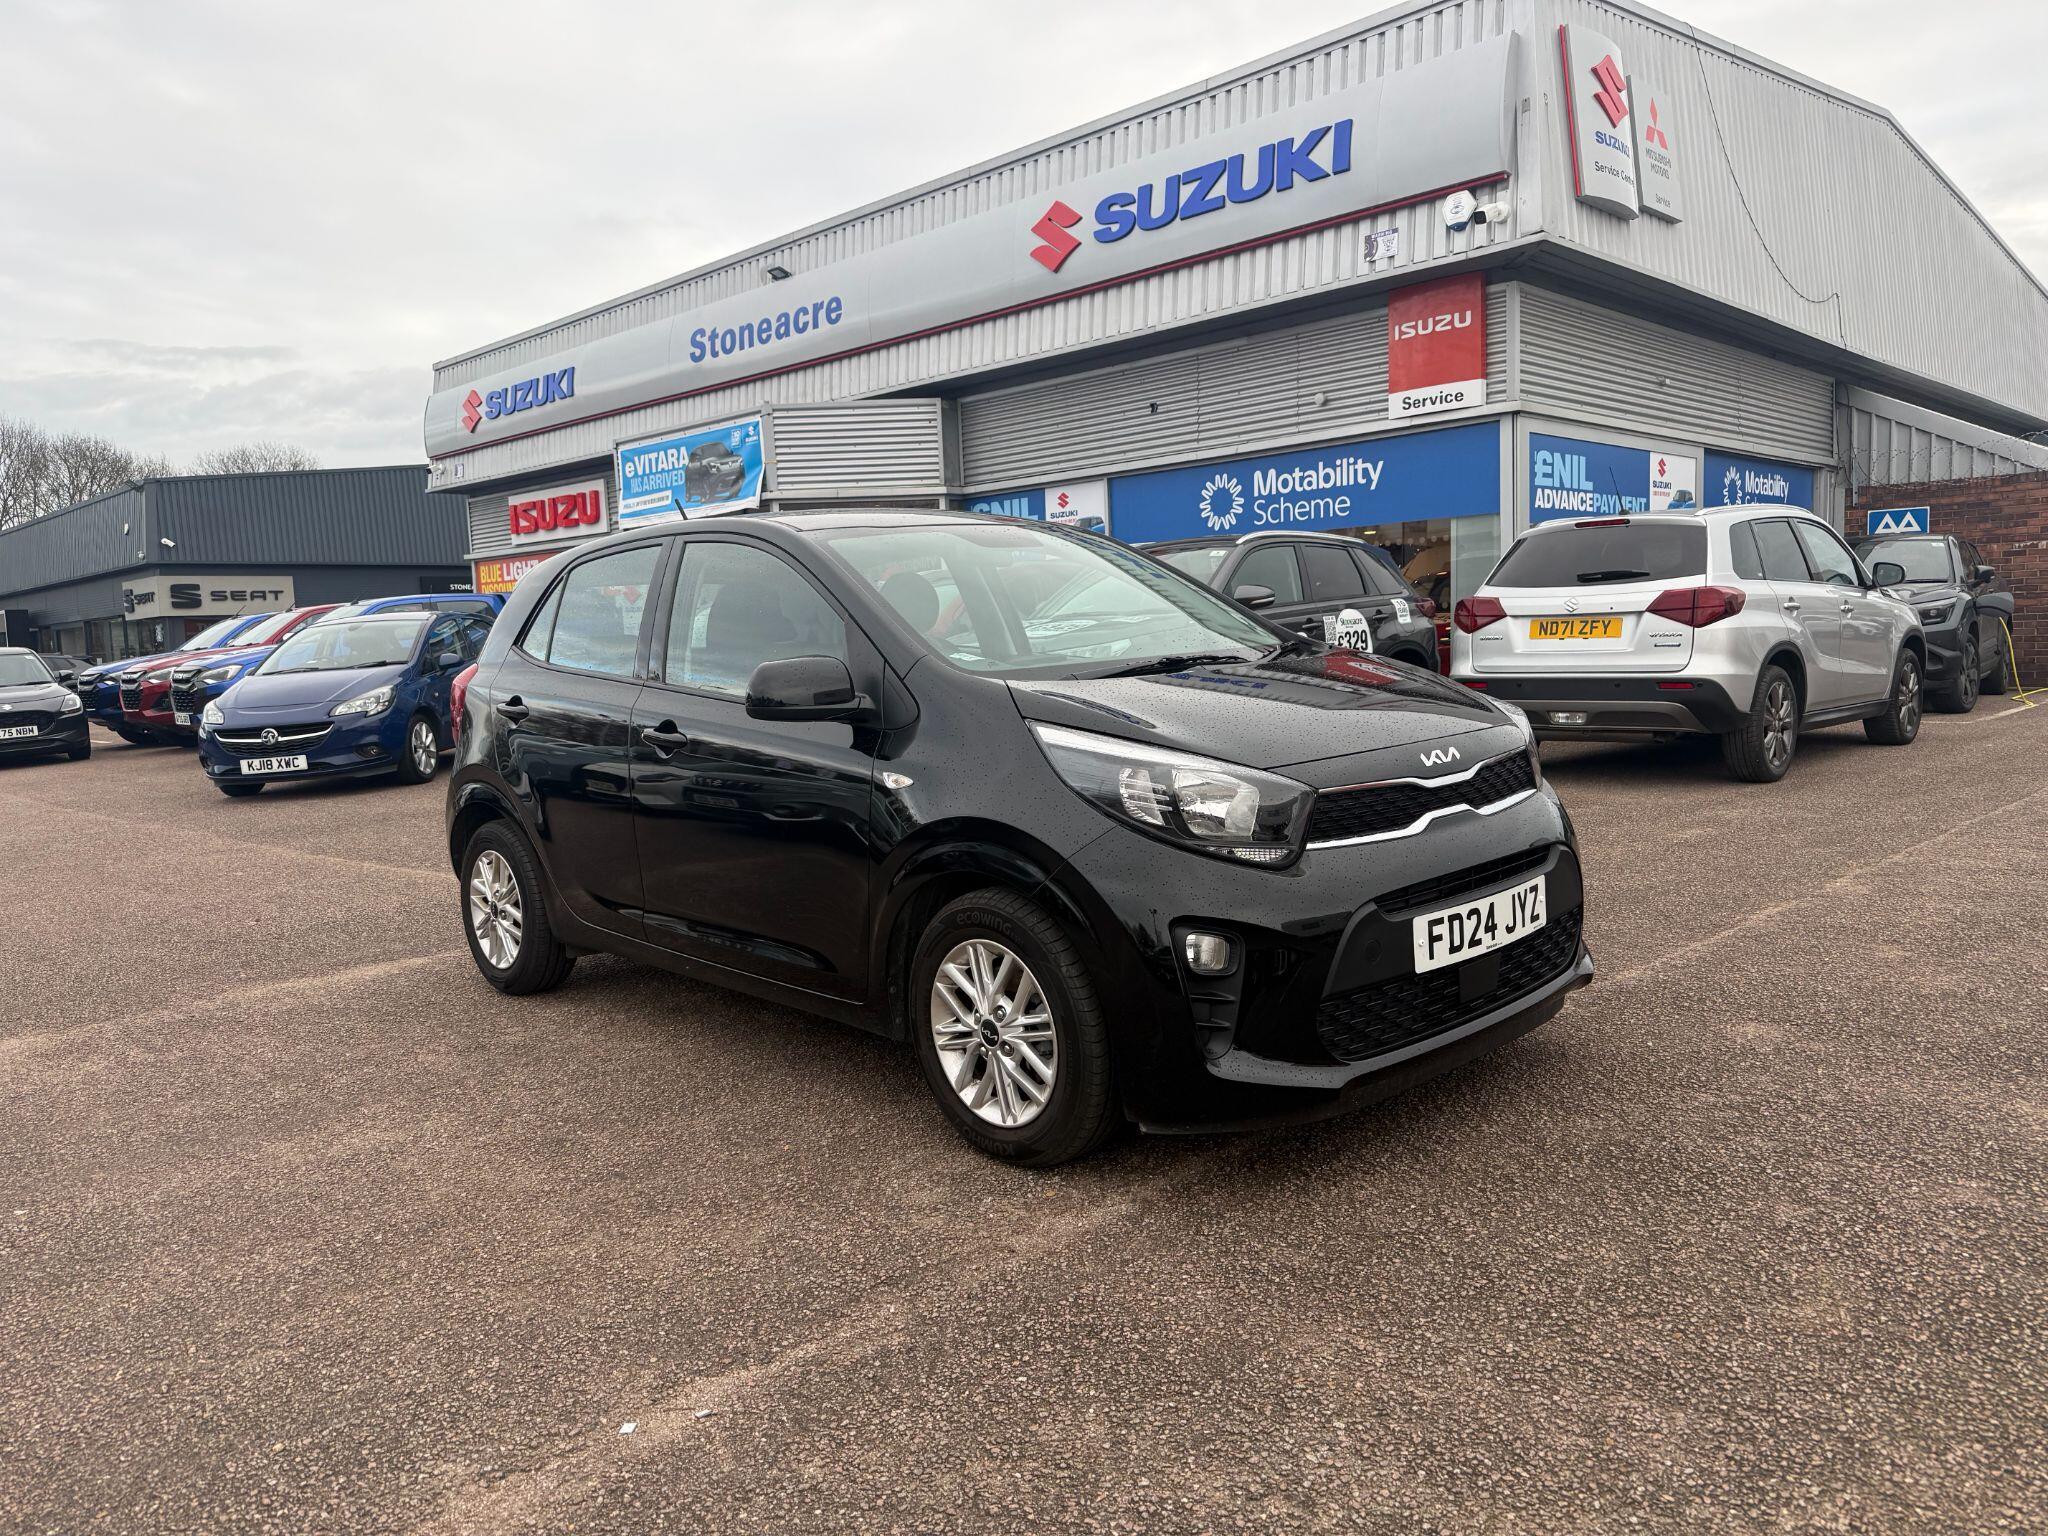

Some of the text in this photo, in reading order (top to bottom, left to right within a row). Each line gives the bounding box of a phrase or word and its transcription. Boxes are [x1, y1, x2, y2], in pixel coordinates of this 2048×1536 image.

[1093, 118, 1353, 244] SUZUKI
[1594, 160, 1620, 178] Service
[689, 296, 843, 364] Stoneacre
[1394, 310, 1472, 341] ISUZU
[485, 366, 576, 420] SUZUKI
[1402, 391, 1465, 410] Service
[625, 446, 690, 478] eVITARA
[1534, 449, 1594, 491] £NIL
[643, 468, 686, 492] ARRIVED
[1253, 456, 1385, 497] Motability
[1652, 480, 1672, 490] SUZUKI
[1745, 469, 1790, 503] Motability
[509, 490, 600, 535] ISUZU
[1050, 509, 1078, 520] SUZUKI
[1253, 495, 1351, 525] Scheme
[480, 564, 502, 583] BLUE
[134, 591, 156, 605] SEAT
[210, 590, 284, 602] SEAT
[1538, 619, 1612, 636] ND71 ZFY
[1337, 629, 1368, 651] £329
[0, 727, 35, 738] 75 NBM
[247, 757, 300, 772] KJ18 XWC
[1427, 883, 1540, 961] FD24 JYZ
